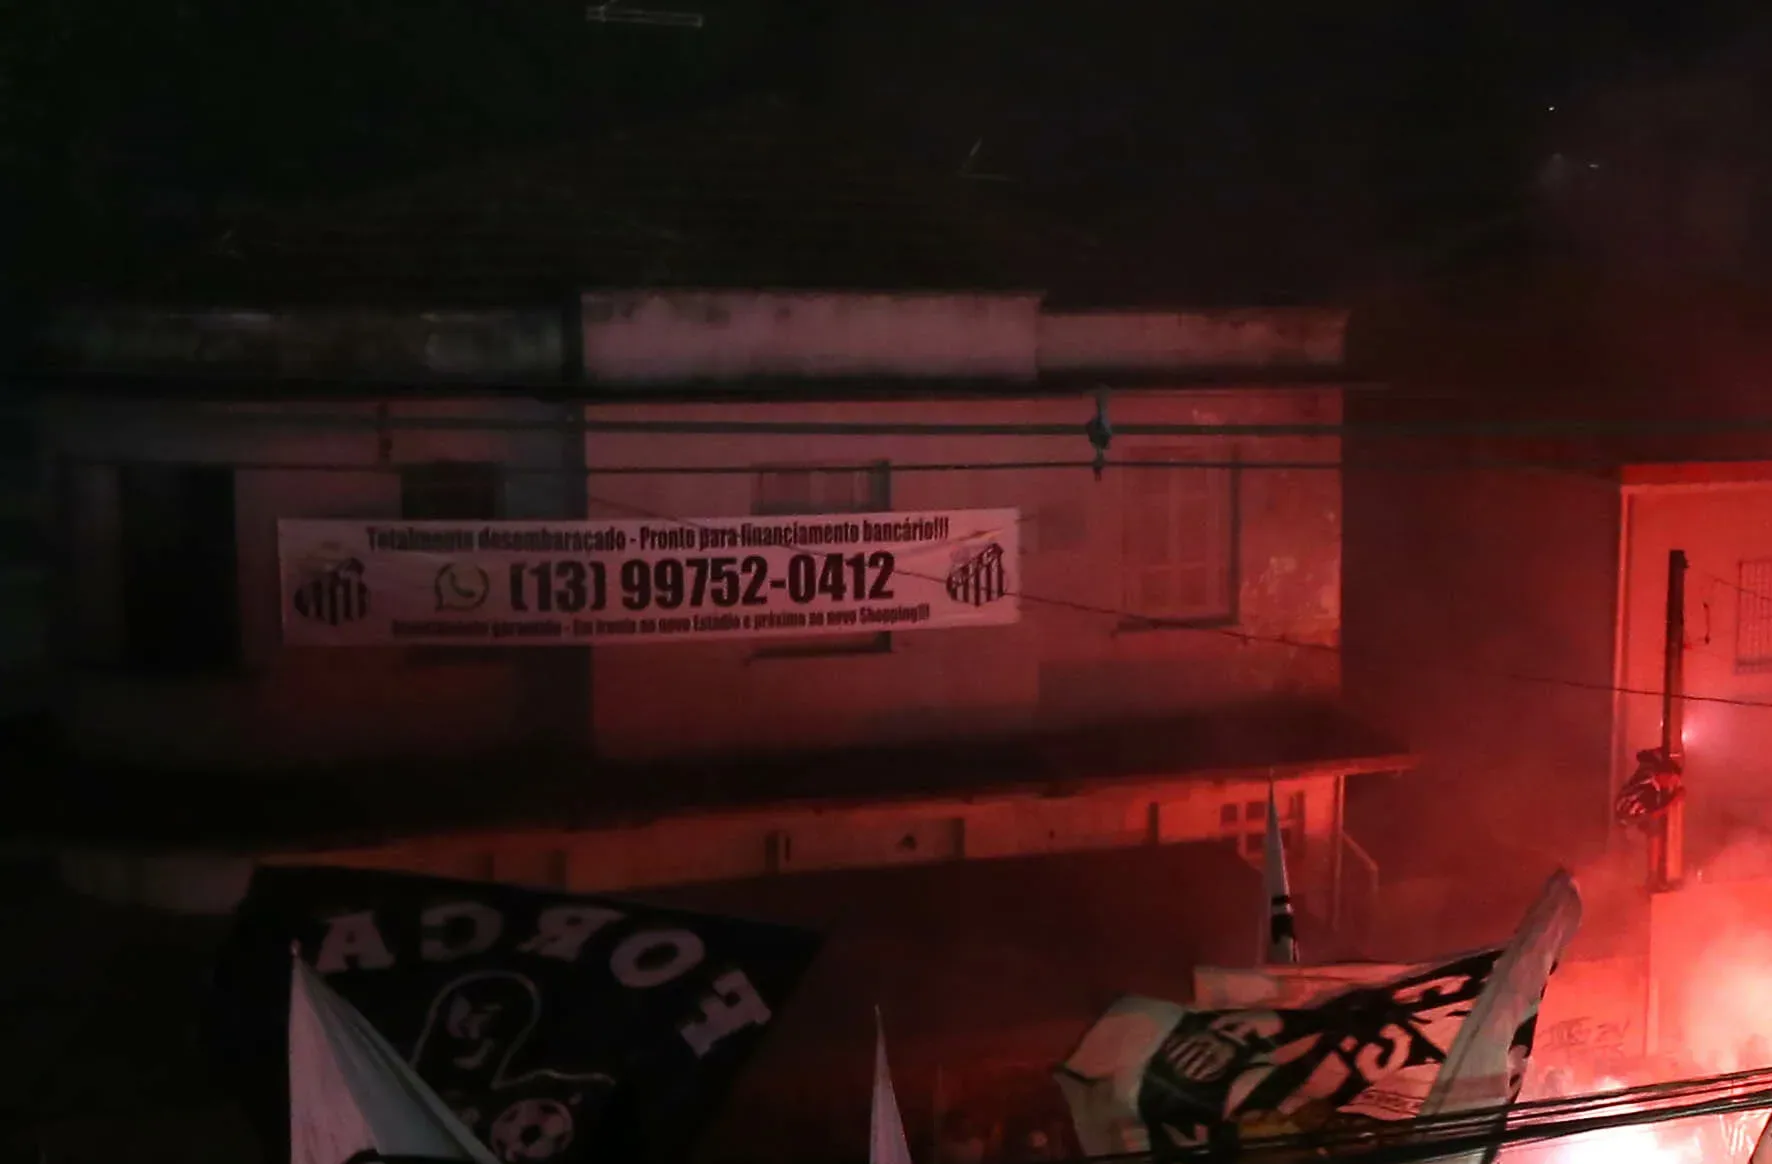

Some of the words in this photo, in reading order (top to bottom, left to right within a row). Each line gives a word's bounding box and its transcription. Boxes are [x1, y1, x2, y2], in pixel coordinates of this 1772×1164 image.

[366, 526, 474, 552] Totalmente
[478, 526, 626, 553] desembaraçado
[639, 523, 696, 550] Pronto
[699, 526, 737, 552] para
[740, 521, 859, 548] financiamento
[862, 516, 949, 542] bancário!!!
[510, 559, 606, 613] (13)
[620, 550, 896, 611] 99752-0412
